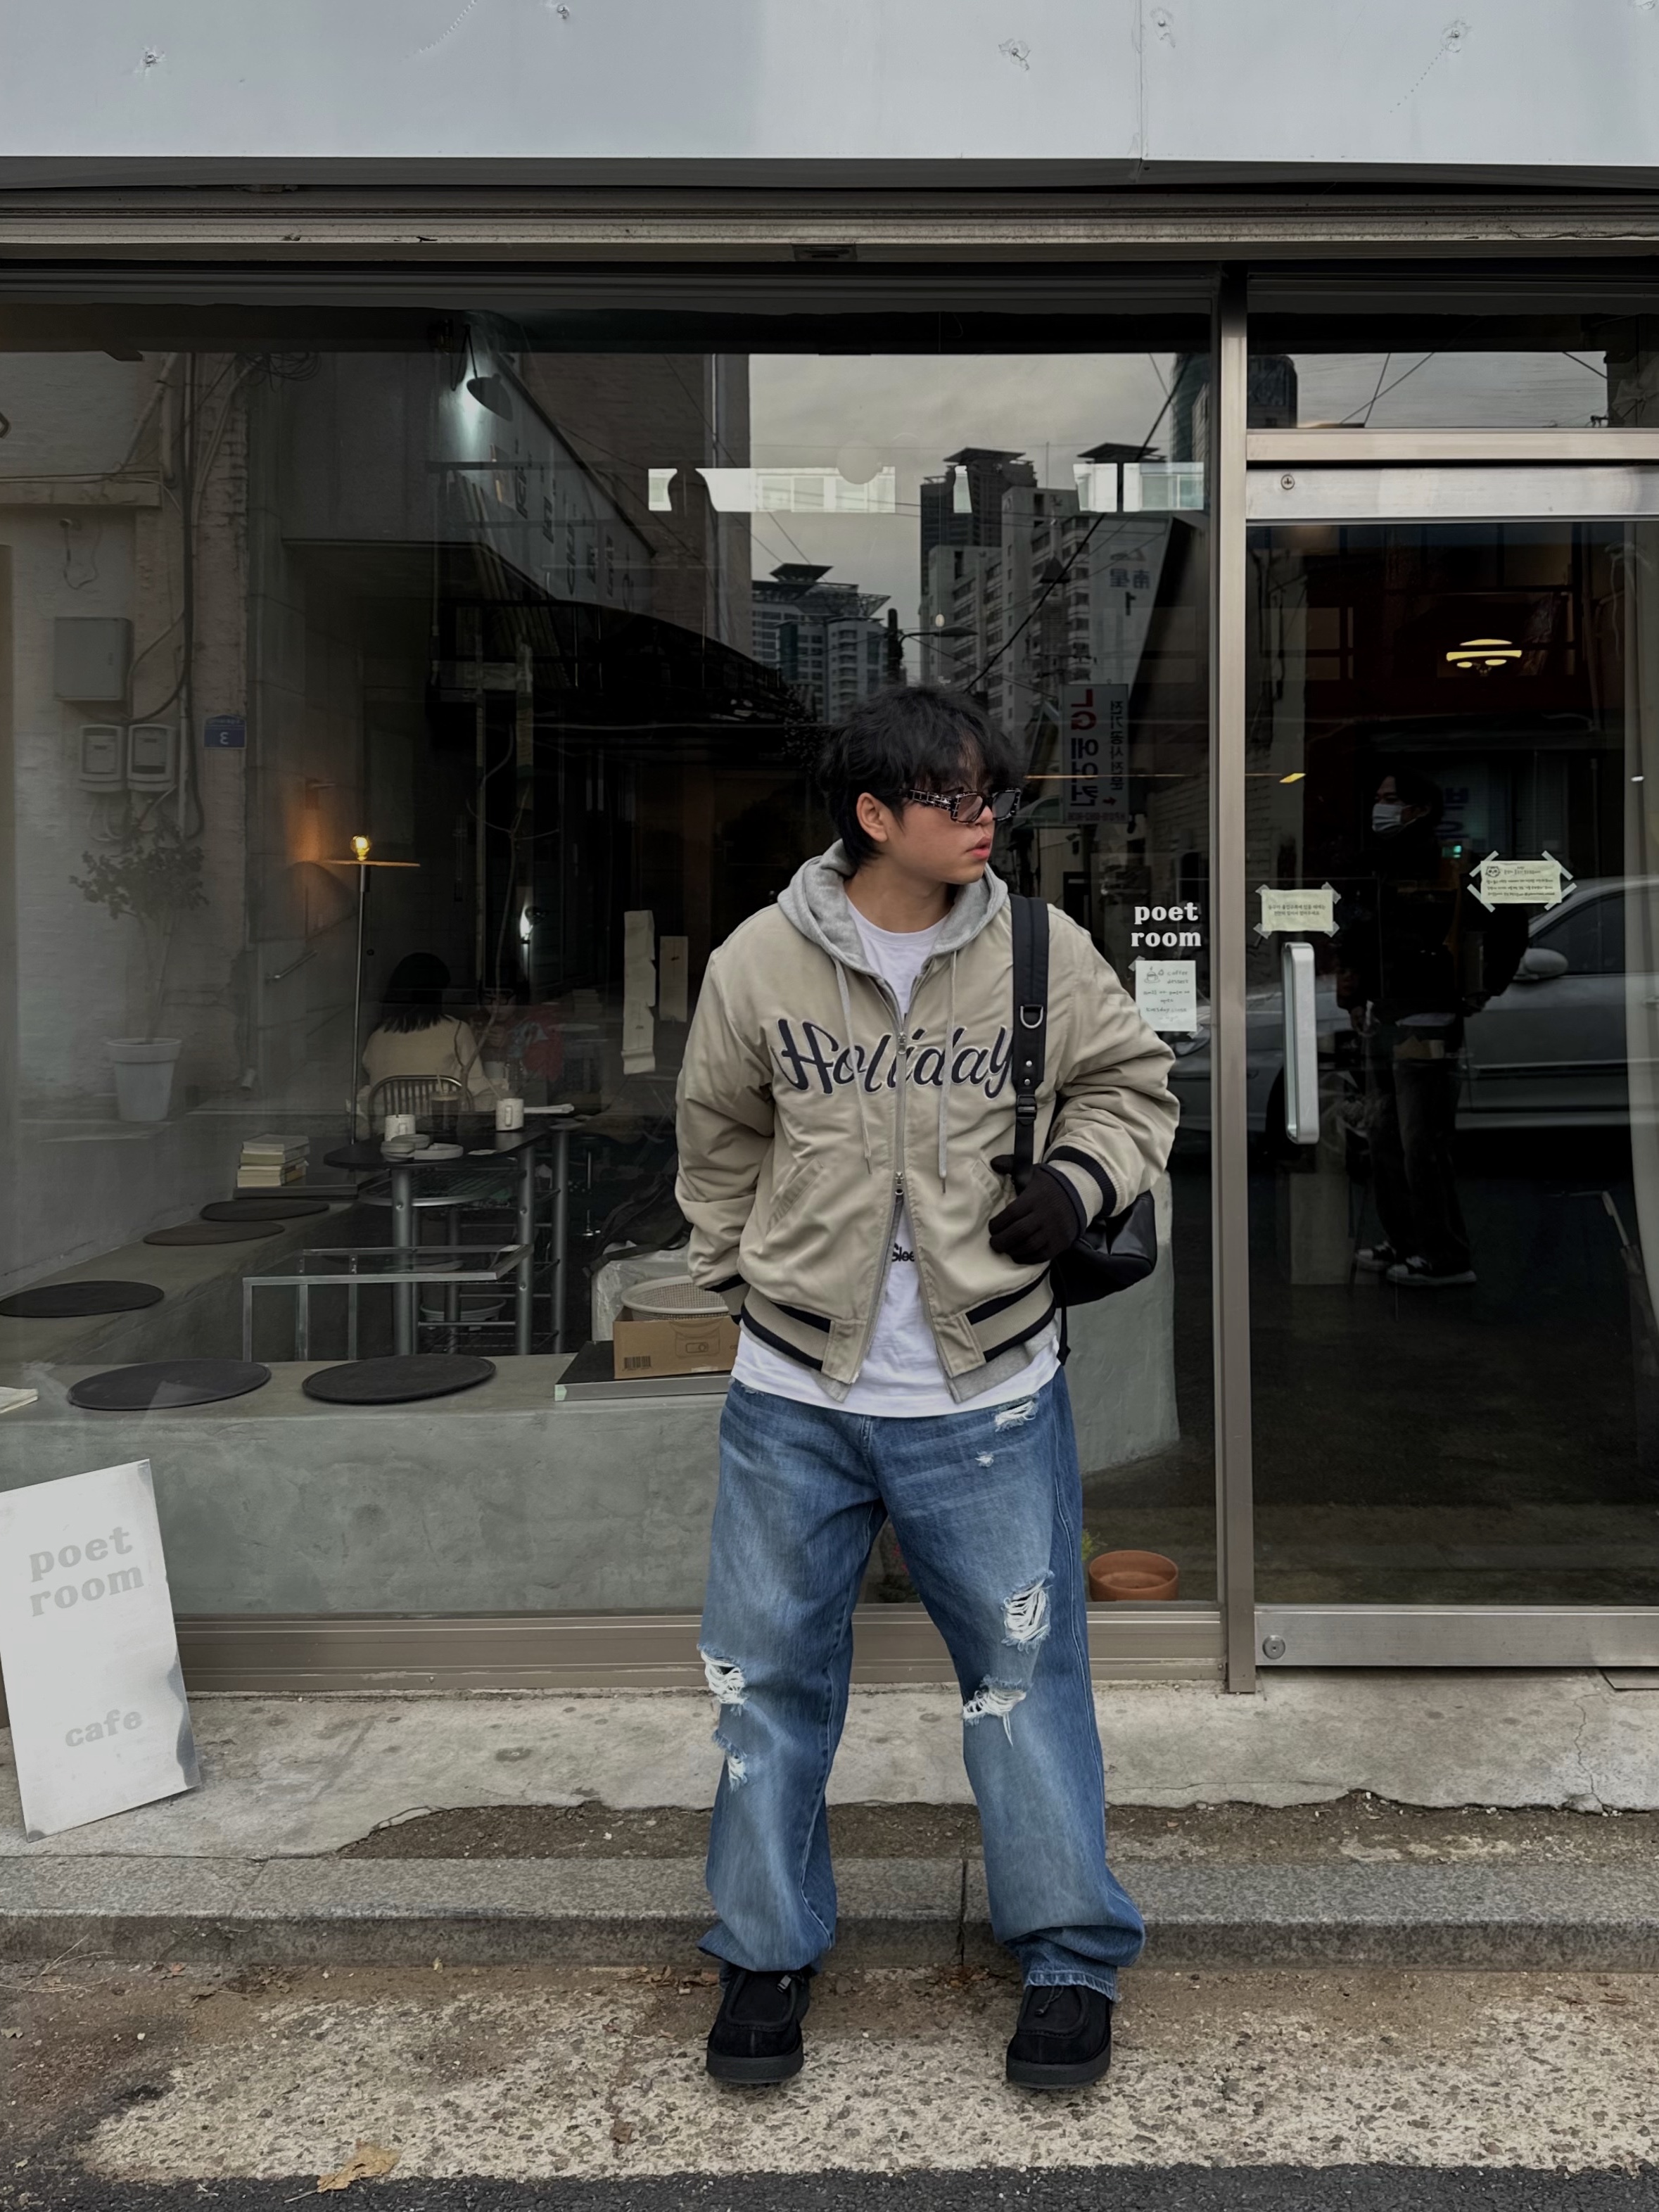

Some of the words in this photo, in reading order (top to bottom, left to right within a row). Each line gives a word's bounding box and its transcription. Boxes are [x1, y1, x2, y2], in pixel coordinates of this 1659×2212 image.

[1134, 902, 1198, 924] poet
[1131, 932, 1202, 947] room
[770, 1018, 1013, 1099] Holiday
[29, 1526, 134, 1582] poet
[29, 1565, 145, 1617] room
[65, 1708, 144, 1748] cafe
